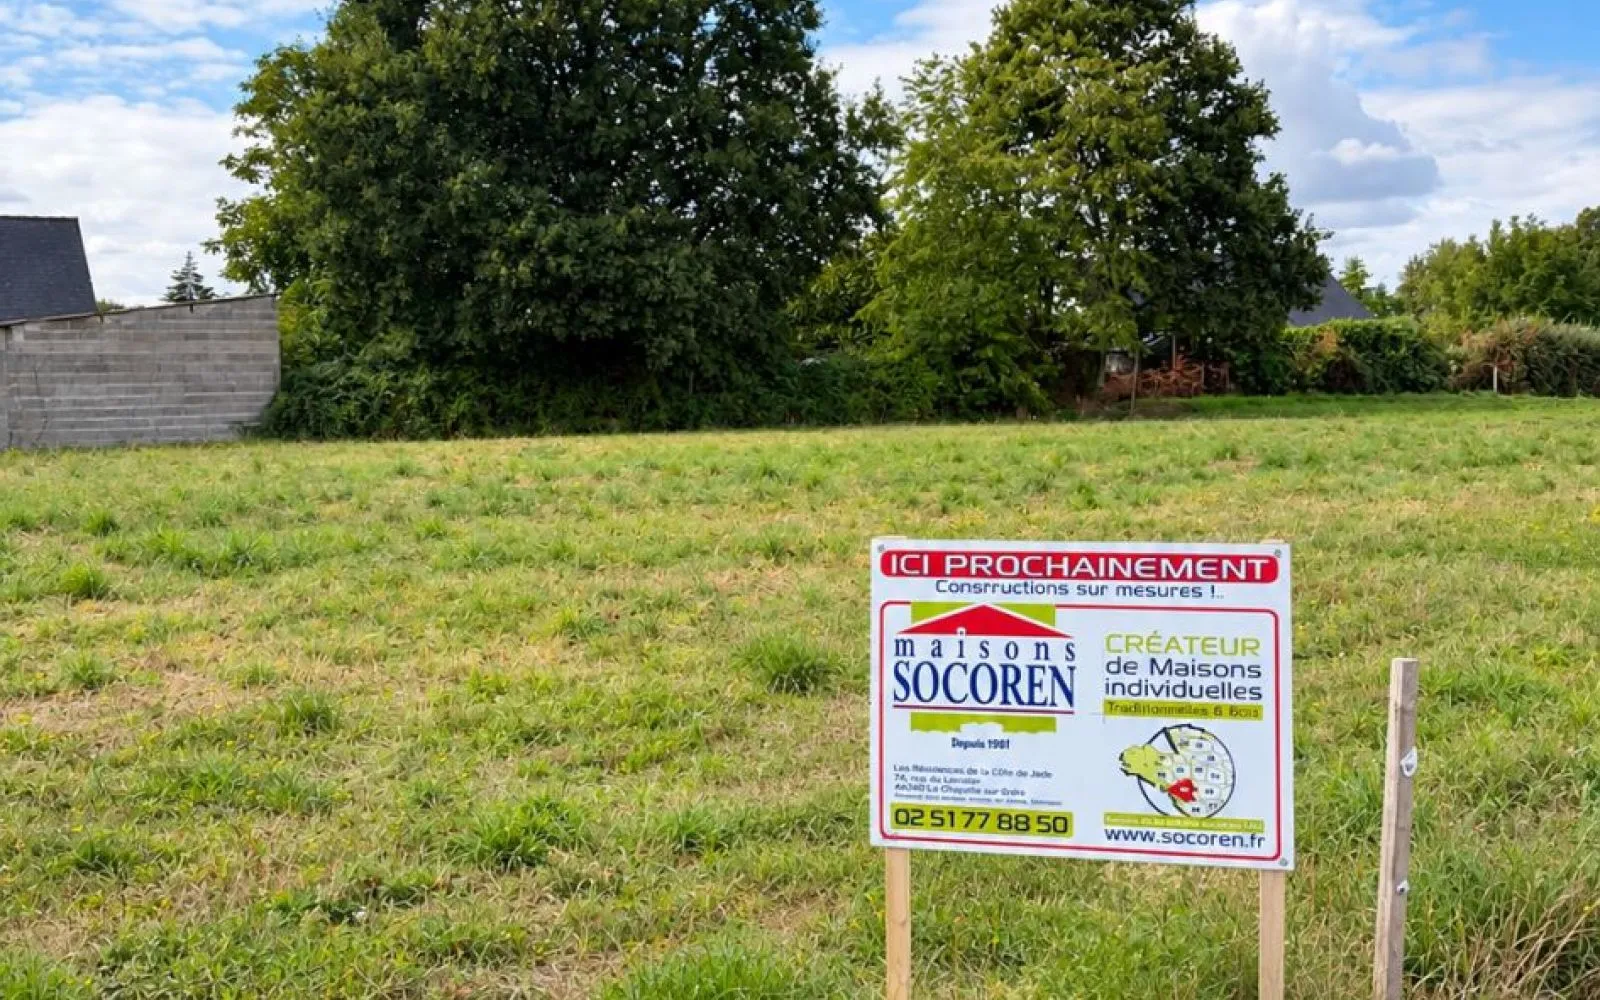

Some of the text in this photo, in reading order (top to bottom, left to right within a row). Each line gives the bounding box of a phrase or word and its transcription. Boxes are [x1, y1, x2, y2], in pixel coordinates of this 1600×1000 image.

[891, 554, 1270, 581] ICI PROCHAINEMENT
[1076, 584, 1107, 597] sur
[1115, 585, 1203, 598] mesures
[894, 630, 1077, 662] maisons
[1105, 630, 1261, 657] CRÉATEUR
[1105, 656, 1262, 679] de Maisons
[893, 660, 1077, 708] SOCOREN
[1105, 677, 1263, 701] individuelles
[894, 808, 1068, 834] 02 51 77 88 50
[1104, 828, 1266, 849] www.socoren.fr
